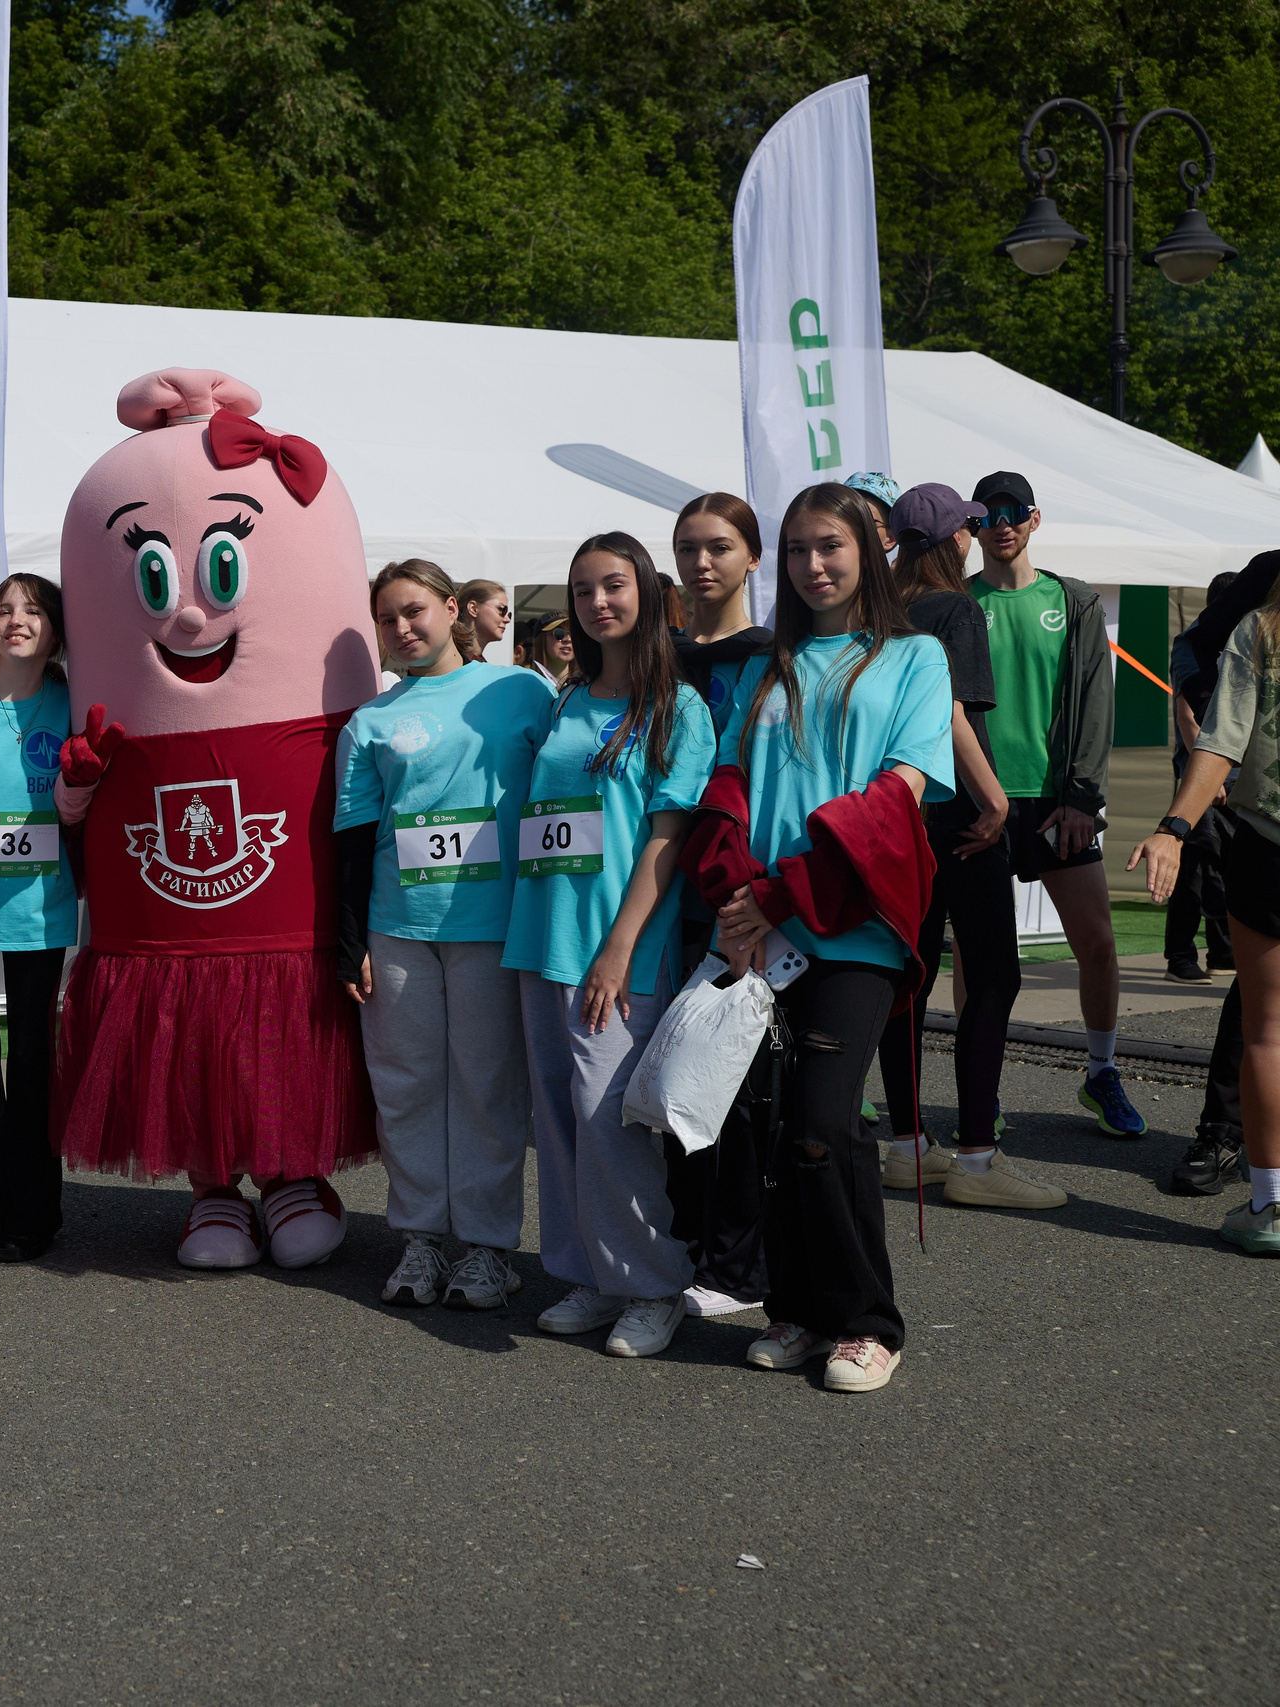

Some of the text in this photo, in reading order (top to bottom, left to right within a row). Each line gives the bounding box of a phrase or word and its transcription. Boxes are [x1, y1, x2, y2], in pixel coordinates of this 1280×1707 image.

[788, 297, 842, 483] БЕР
[27, 777, 57, 794] ВБМ
[1, 832, 32, 856] 36
[428, 832, 462, 860] 31
[542, 822, 571, 850] 60
[158, 863, 255, 897] РАТИМИР
